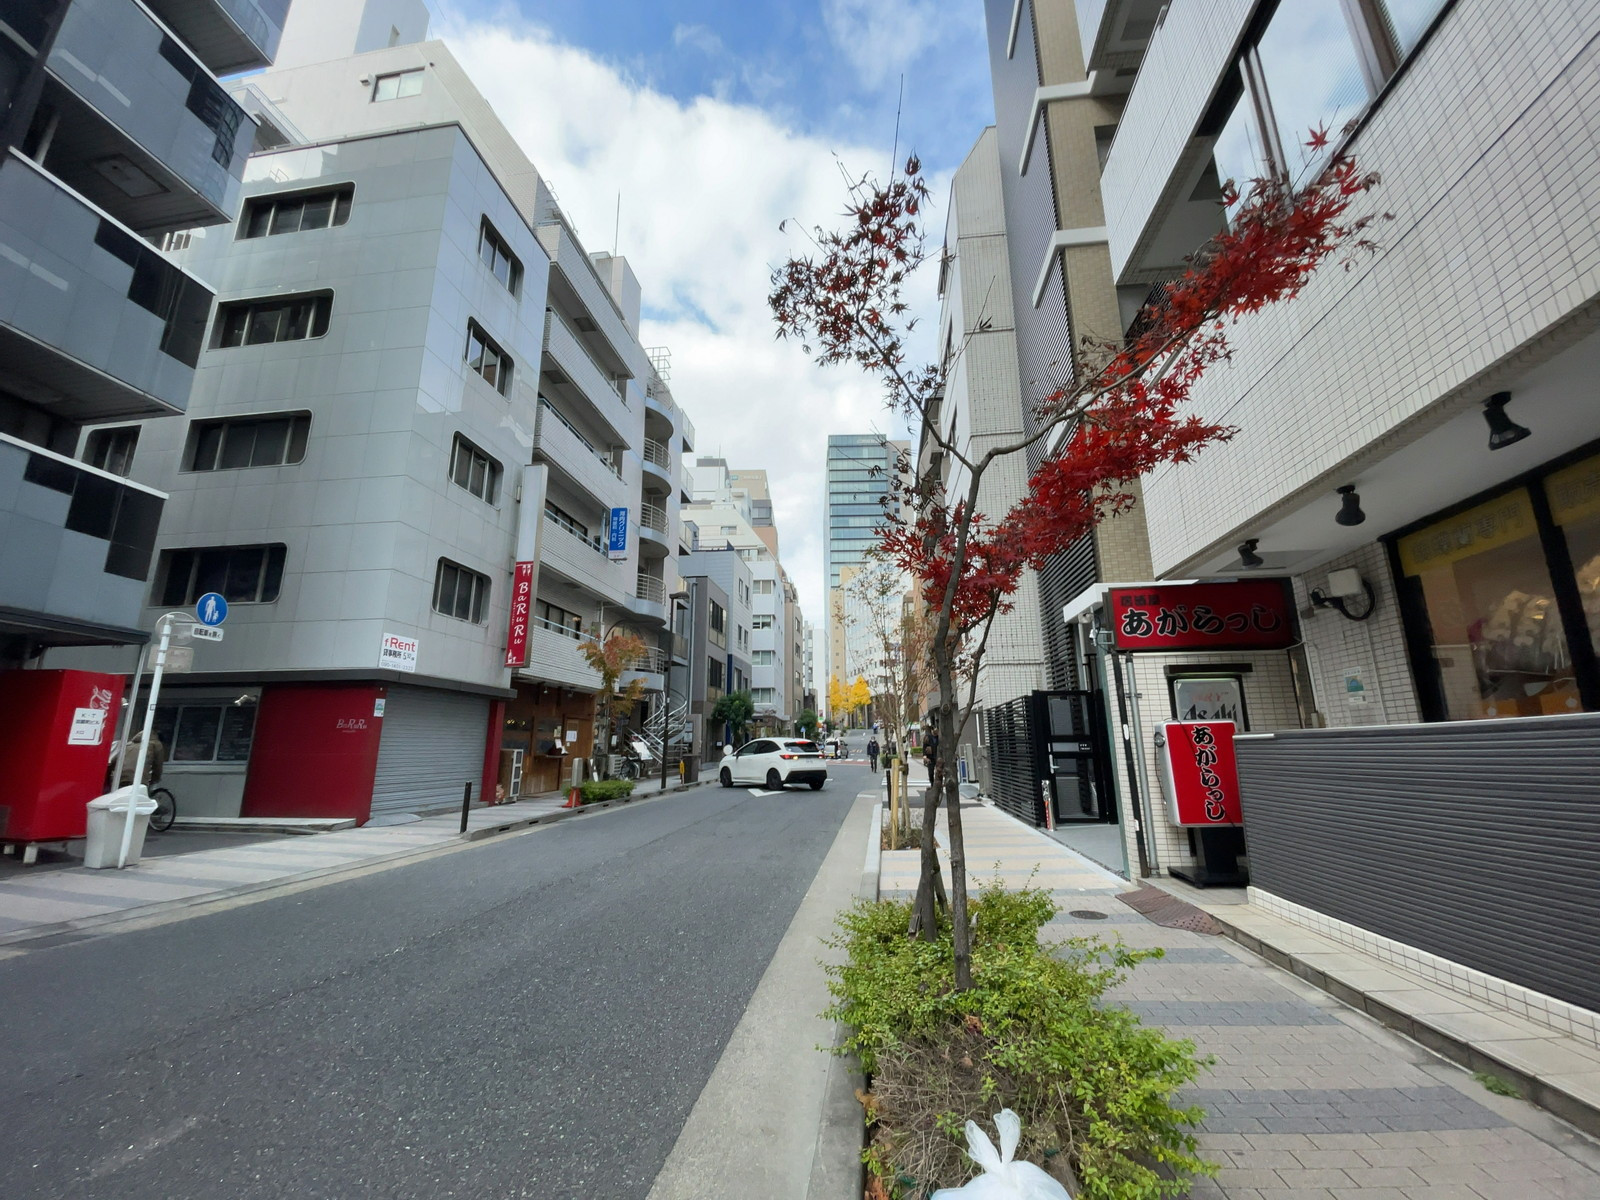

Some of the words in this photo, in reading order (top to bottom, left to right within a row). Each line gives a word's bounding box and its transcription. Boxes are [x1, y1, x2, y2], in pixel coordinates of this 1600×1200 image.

[513, 581, 529, 645] BaRuRu
[1121, 603, 1282, 638] あがらっし
[1183, 703, 1238, 722] Asahi
[1191, 725, 1226, 822] あがらっし
